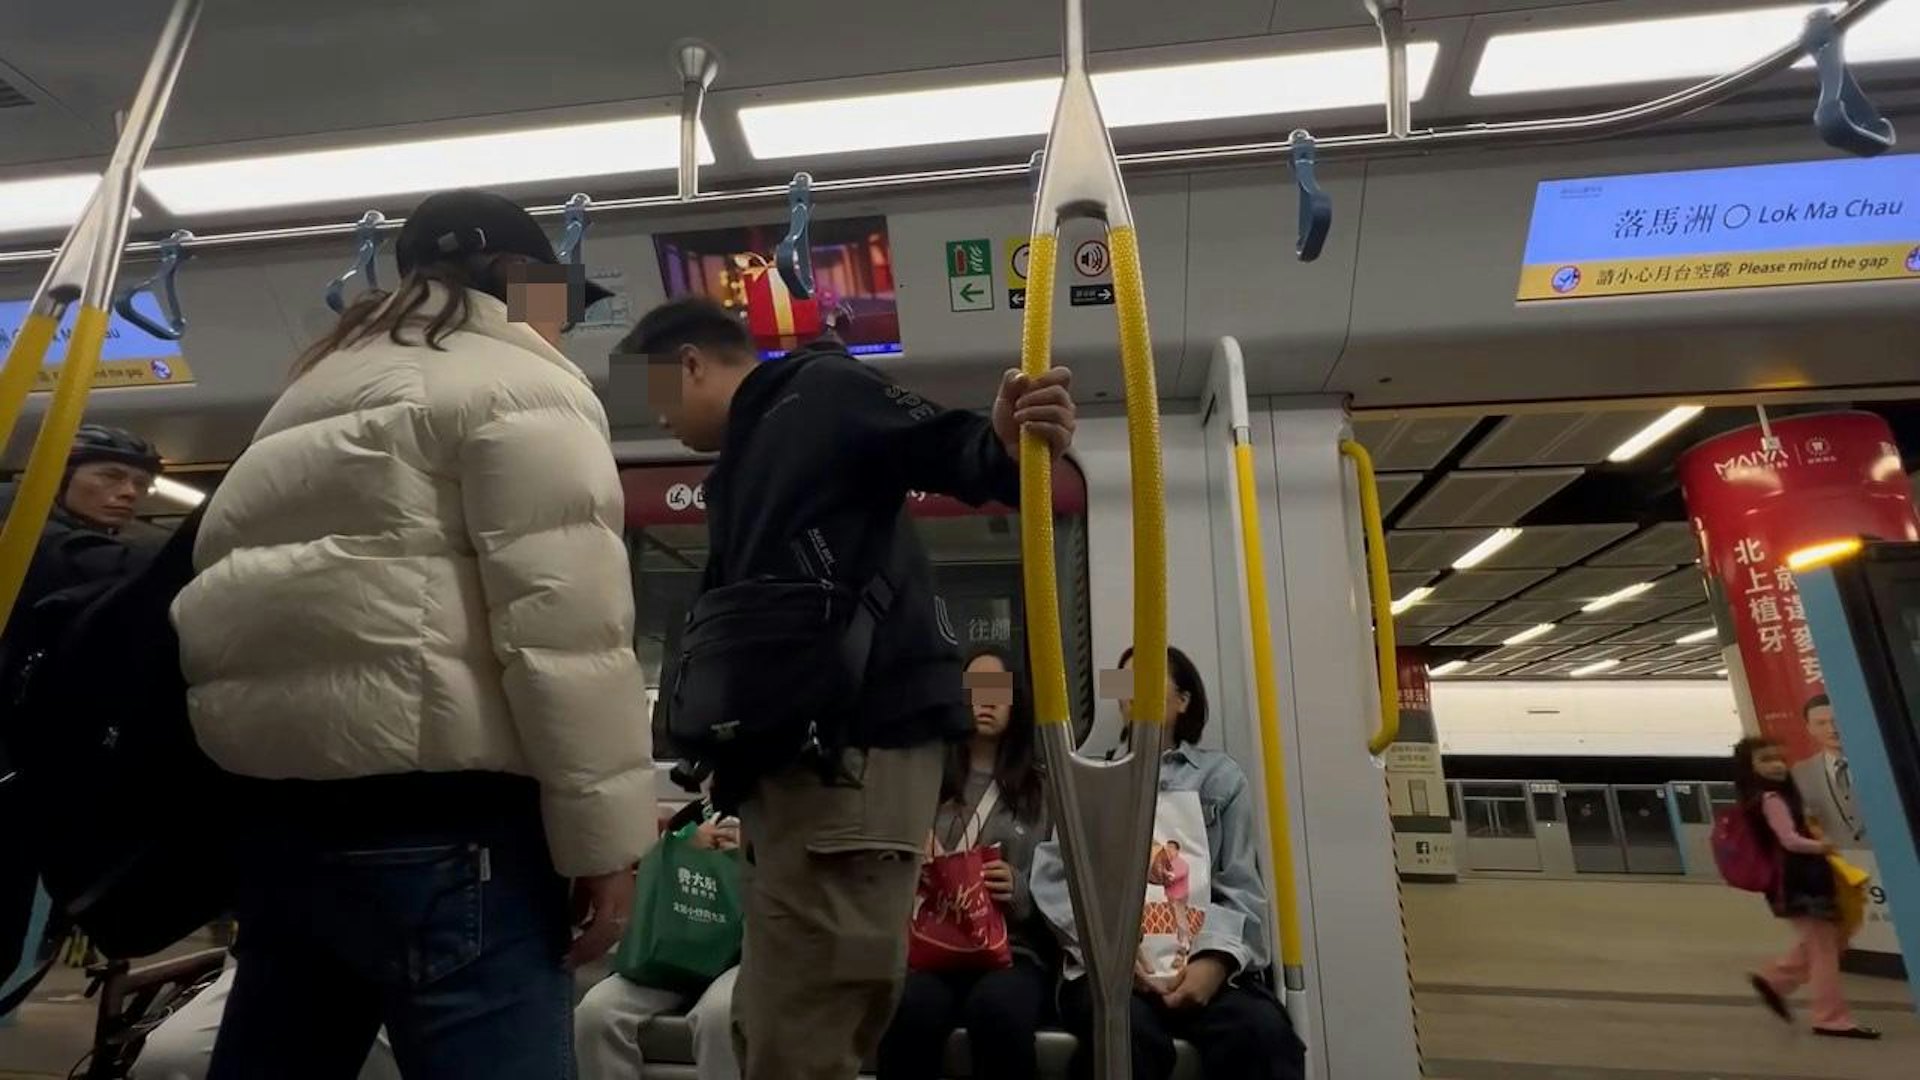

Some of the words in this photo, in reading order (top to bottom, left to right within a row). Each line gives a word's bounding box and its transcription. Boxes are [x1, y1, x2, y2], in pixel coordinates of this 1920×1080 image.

[1614, 203, 1718, 239] 落馬洲
[1758, 204, 1799, 224] Lok
[1803, 201, 1838, 221] Ma
[1845, 198, 1904, 217] Chau
[1595, 261, 1732, 286] 請小心月台空隙
[1738, 262, 1786, 275] Please
[1787, 257, 1829, 272] mind
[1830, 255, 1857, 269] the
[1858, 255, 1889, 272] gap
[1713, 450, 1790, 478] MAIYA
[1733, 537, 1787, 653] 北上植牙
